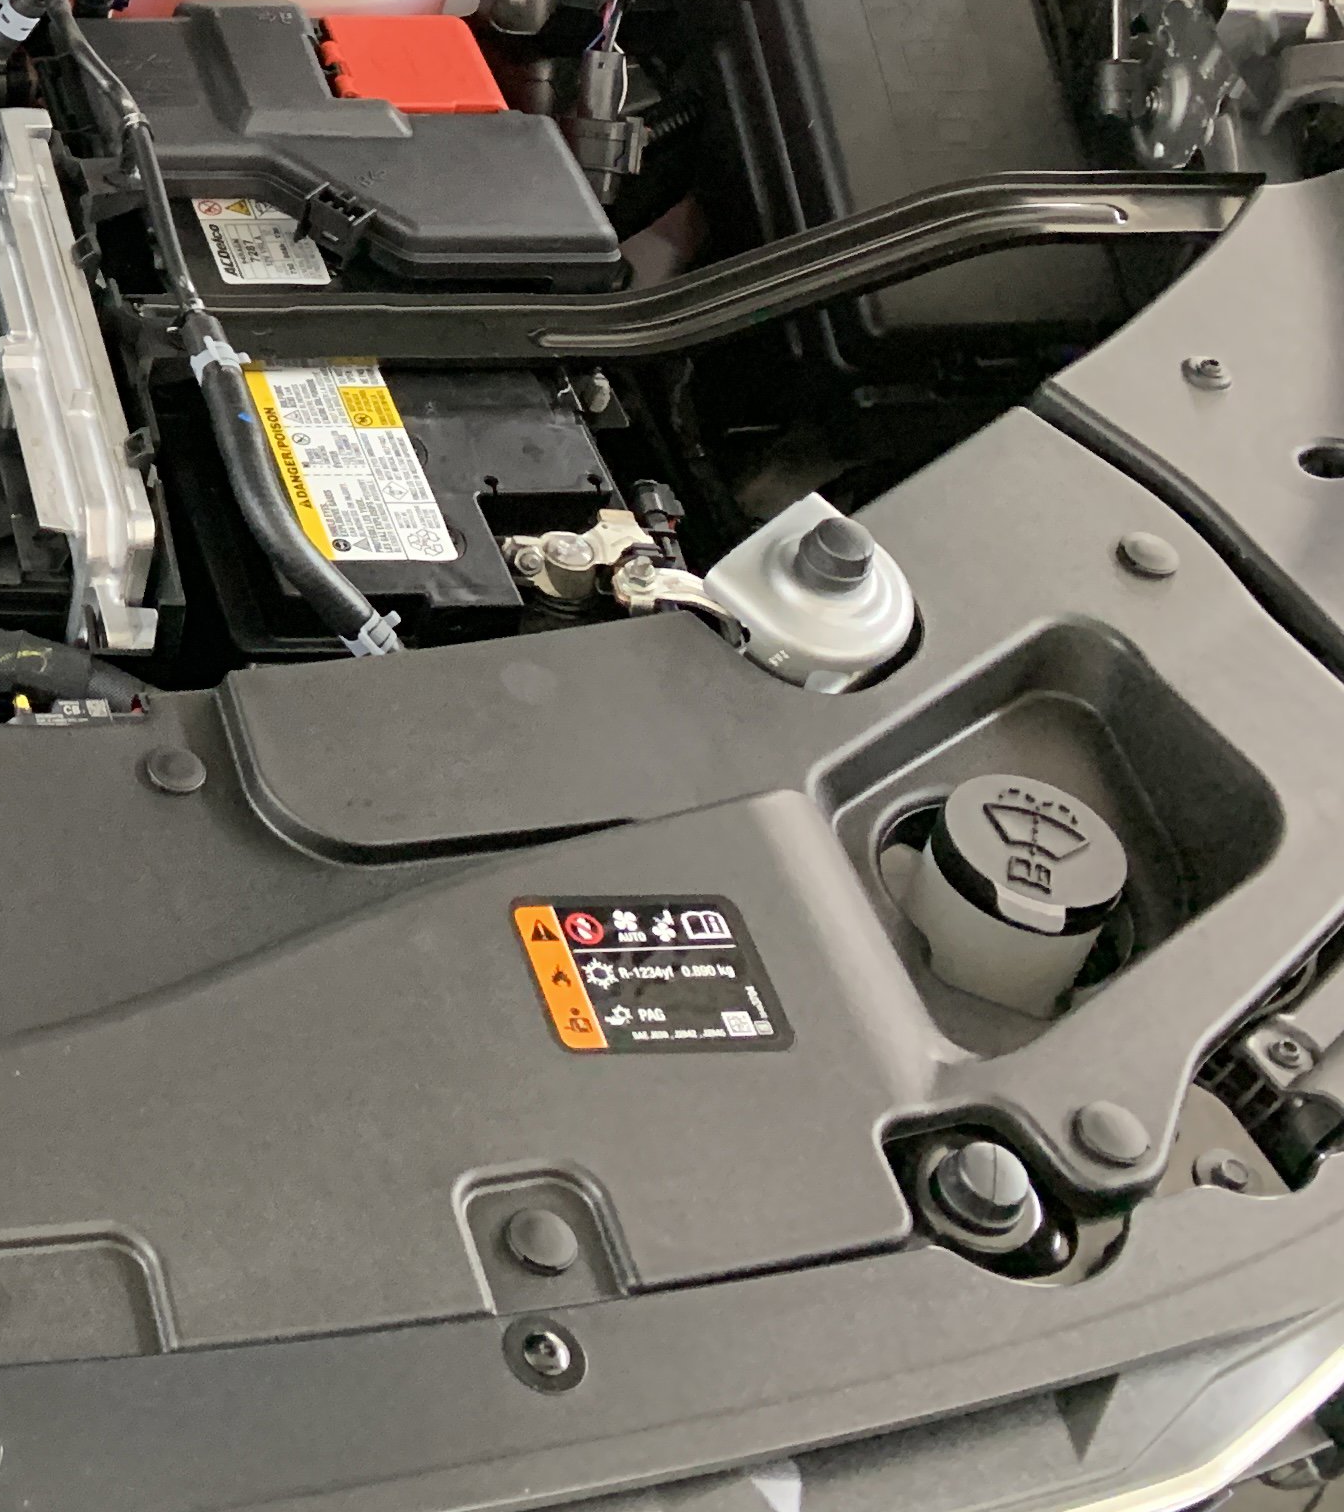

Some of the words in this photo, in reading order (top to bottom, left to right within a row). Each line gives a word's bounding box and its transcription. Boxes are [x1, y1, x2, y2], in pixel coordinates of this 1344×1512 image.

[208, 224, 238, 276] ACDelco
[242, 240, 259, 262] 7287
[264, 407, 308, 498] DANGER/POISON
[299, 716, 376, 726] ACDelco
[618, 932, 647, 943] AUTO
[618, 965, 674, 980] R-1234yf
[717, 963, 736, 979] kg
[637, 1008, 666, 1022] PAG
